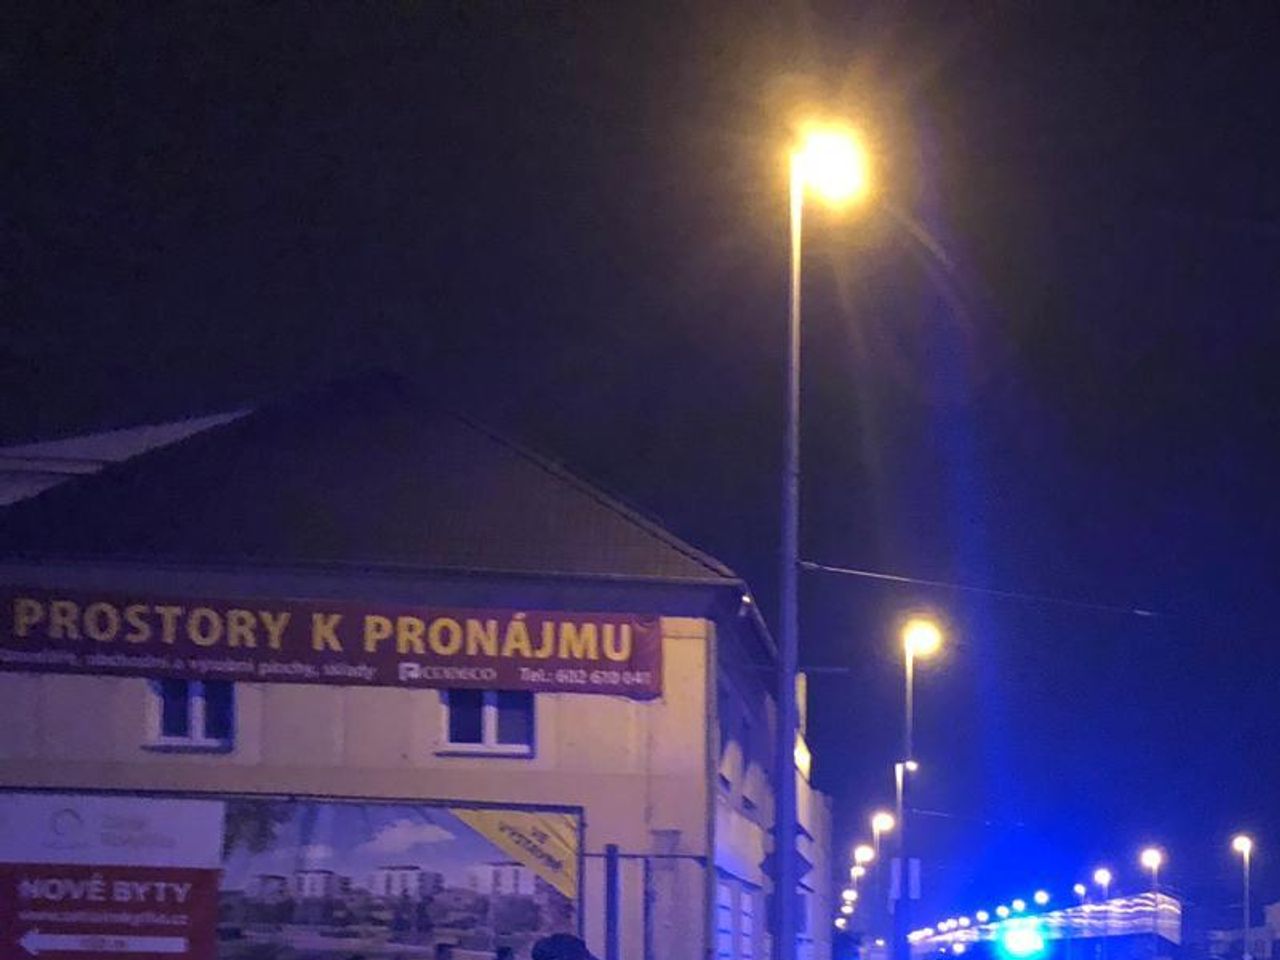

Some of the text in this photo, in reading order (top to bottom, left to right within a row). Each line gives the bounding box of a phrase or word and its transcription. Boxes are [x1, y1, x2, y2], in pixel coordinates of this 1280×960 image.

[12, 597, 634, 661] PROSTORY K PRONÁJMU
[17, 873, 192, 903] NOVÉ BYTY
